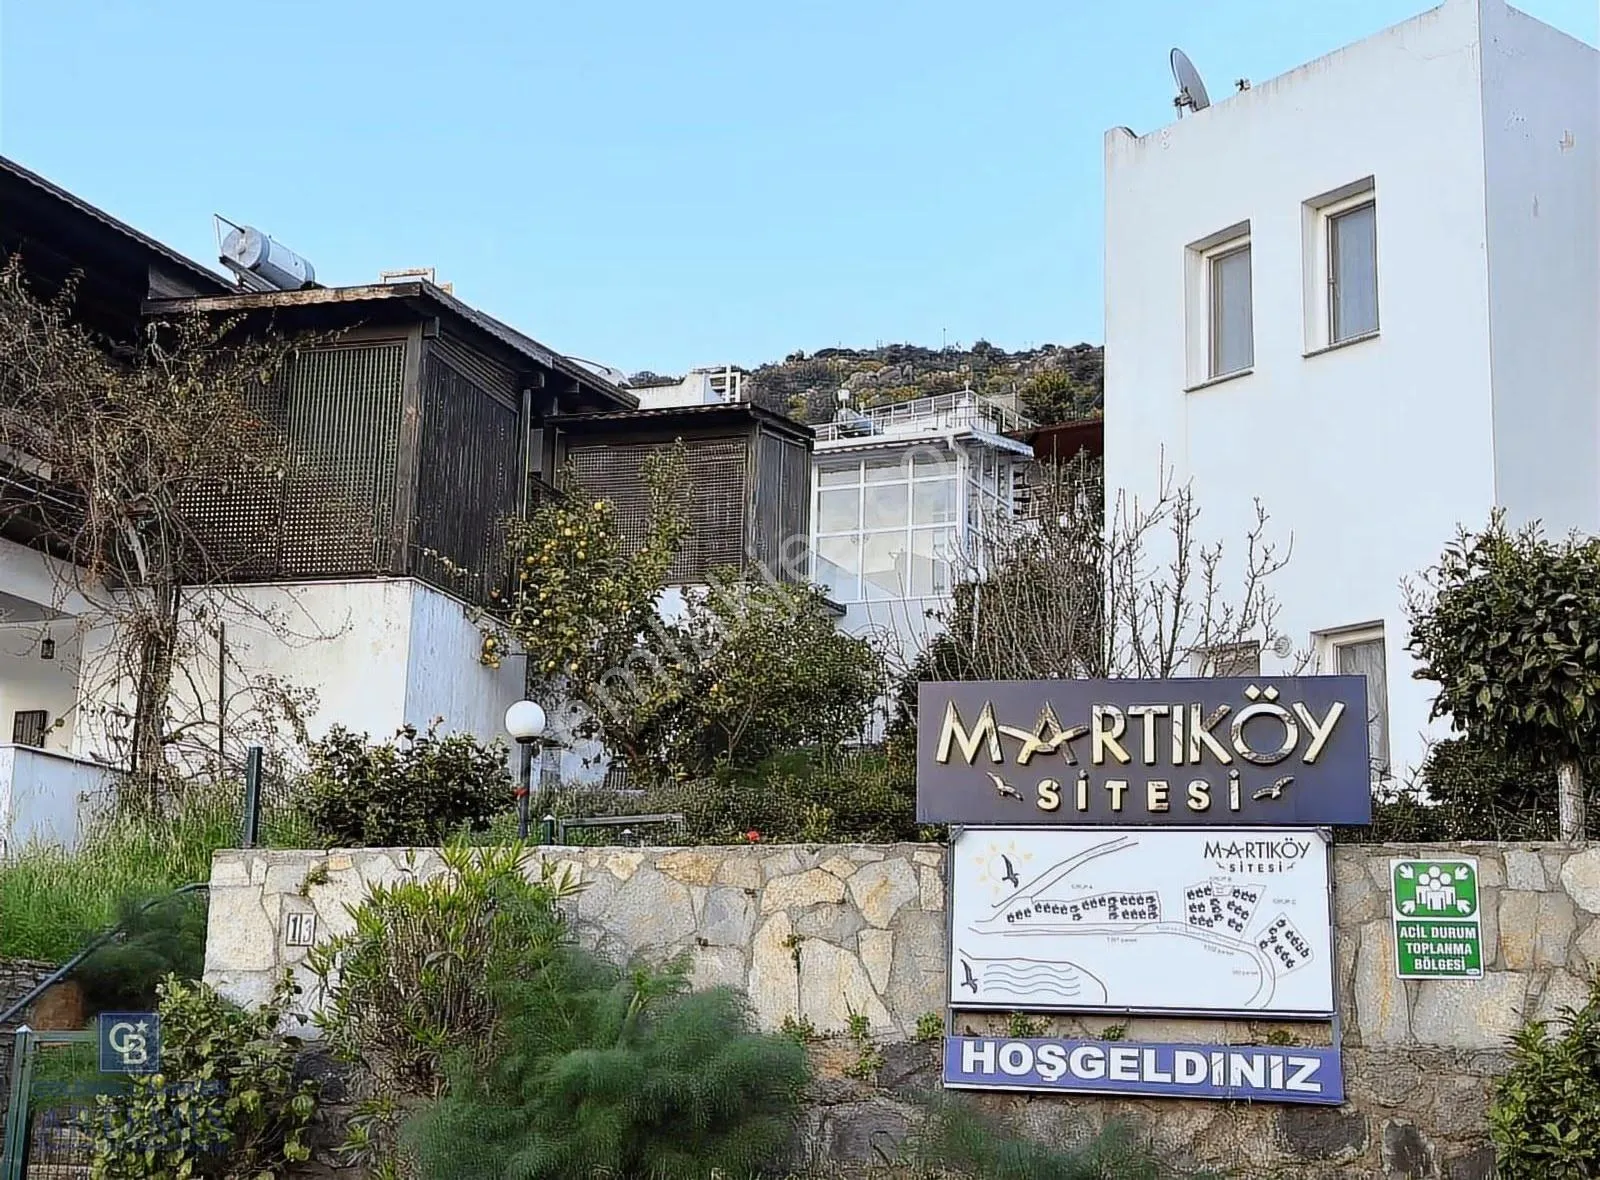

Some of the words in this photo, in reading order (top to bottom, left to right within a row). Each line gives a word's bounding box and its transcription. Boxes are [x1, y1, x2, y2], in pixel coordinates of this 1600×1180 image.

[935, 684, 1345, 766] MARTIKÖY
[1036, 769, 1241, 812] SİTESİ
[1204, 837, 1311, 859] MARTIKÖY
[1229, 860, 1282, 873] SİTESİ
[291, 915, 313, 943] 13
[1400, 924, 1428, 939] ACİL
[1431, 926, 1476, 939] DURUM
[1405, 942, 1472, 955] TOPLANMA
[1414, 955, 1466, 971] BÖLGESİ
